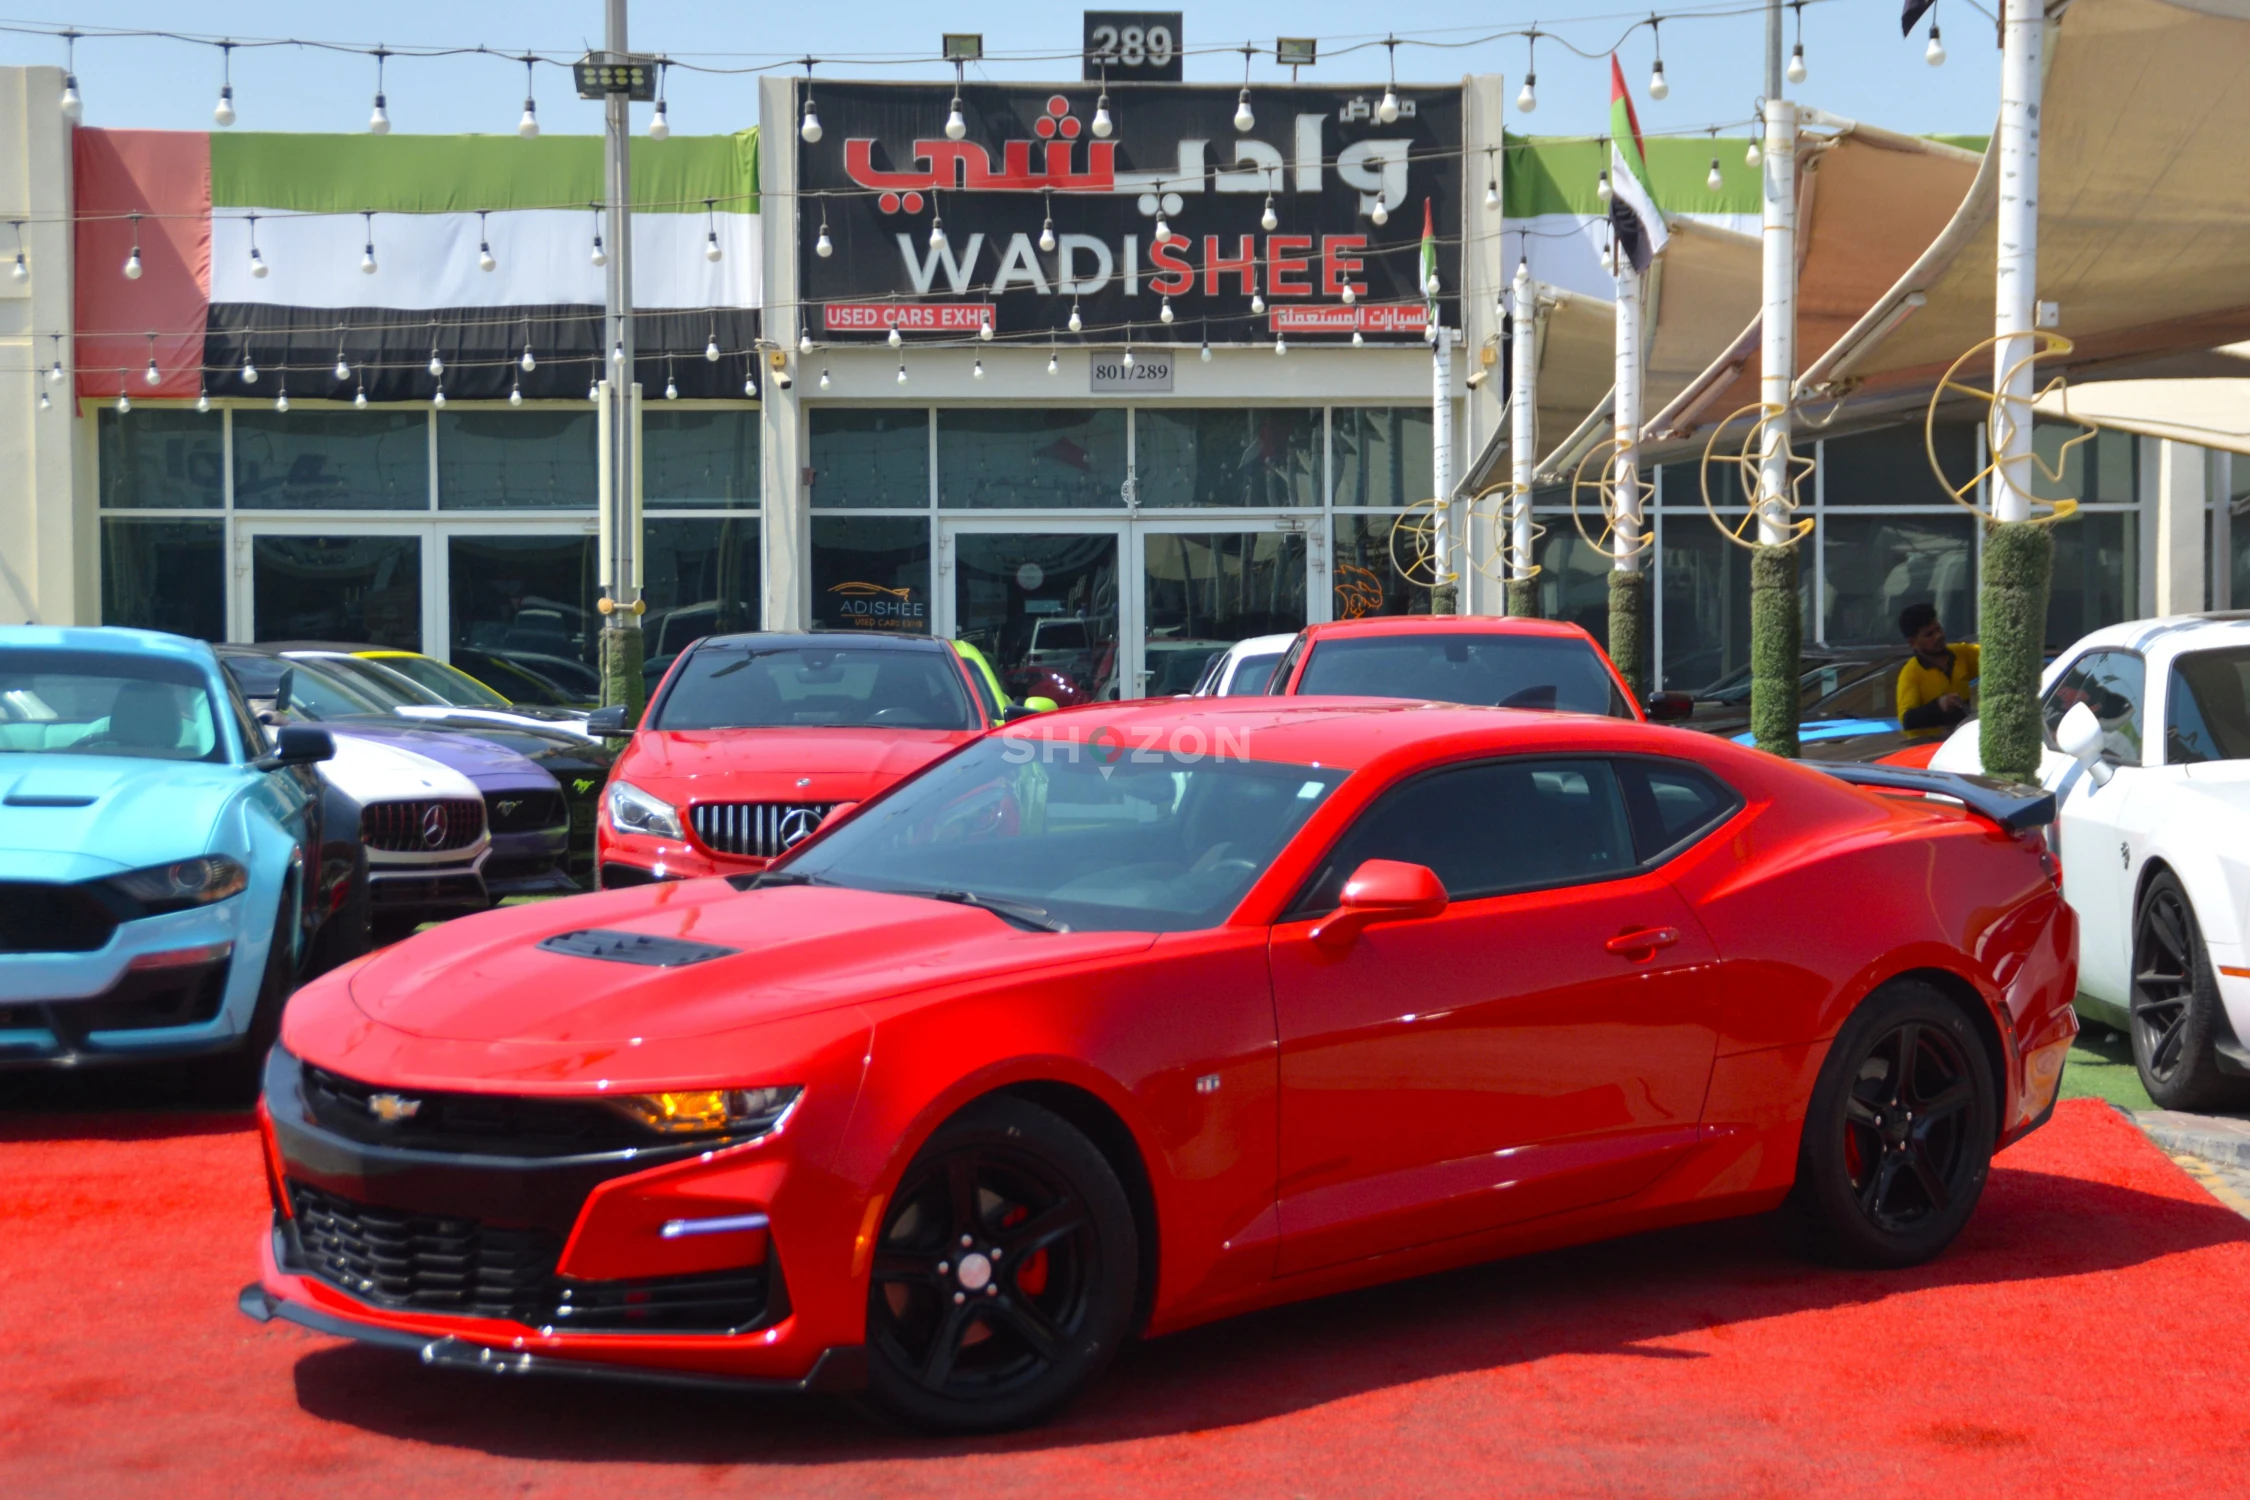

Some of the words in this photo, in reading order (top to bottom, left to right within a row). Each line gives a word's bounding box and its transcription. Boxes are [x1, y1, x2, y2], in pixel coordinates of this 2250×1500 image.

[1092, 25, 1173, 66] 289
[1339, 95, 1416, 126] مرض
[896, 232, 1368, 297] WADISHEE
[828, 308, 878, 326] USED
[883, 308, 934, 326] CARS
[1096, 364, 1169, 381] 801/289
[854, 617, 876, 627] USED
[878, 618, 900, 628] CARS
